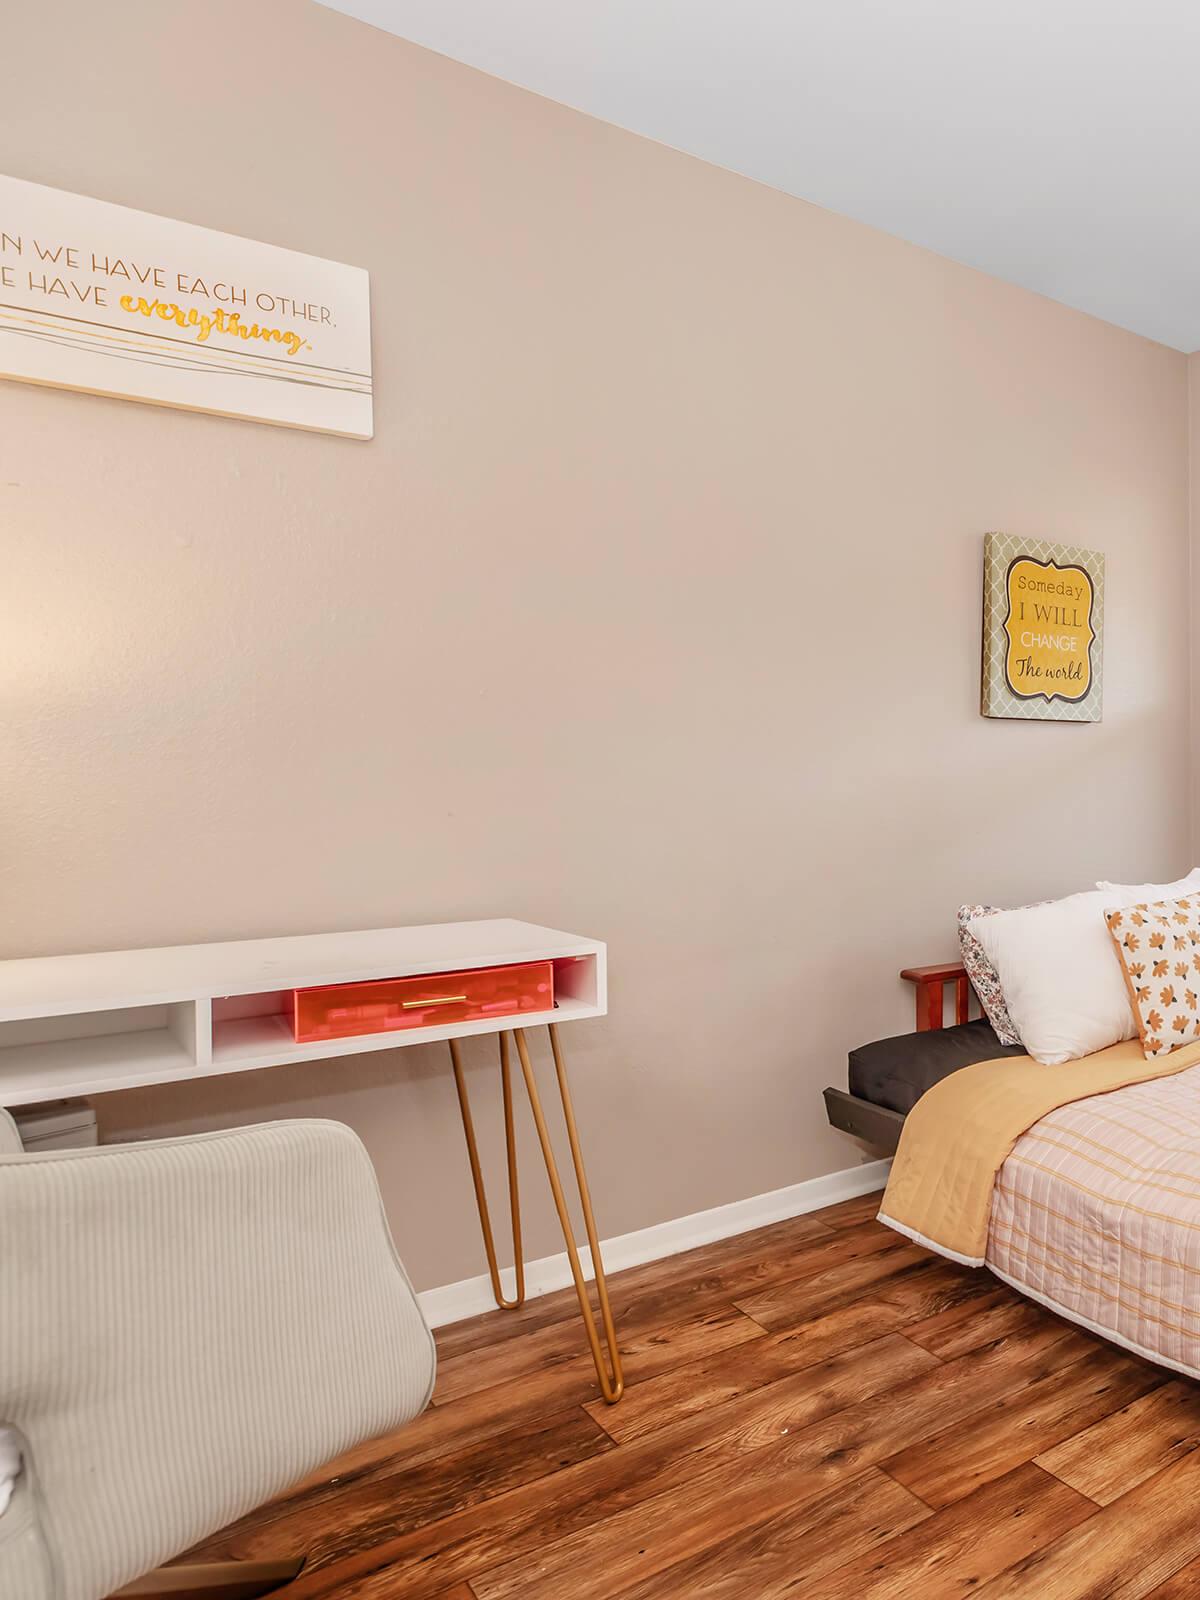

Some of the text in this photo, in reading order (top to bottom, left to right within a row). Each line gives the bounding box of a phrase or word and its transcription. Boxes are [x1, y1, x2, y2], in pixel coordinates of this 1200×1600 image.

[33, 240, 79, 269] WE
[91, 254, 166, 288] HAVE
[177, 273, 247, 306] EACH
[255, 293, 337, 328] OTHER,
[28, 271, 108, 307] HAVE
[119, 294, 313, 356] everything.
[1018, 575, 1083, 600] Someday
[1019, 601, 1082, 627] I WILL
[1021, 632, 1077, 652] CHANGE
[1015, 655, 1083, 680] The world
